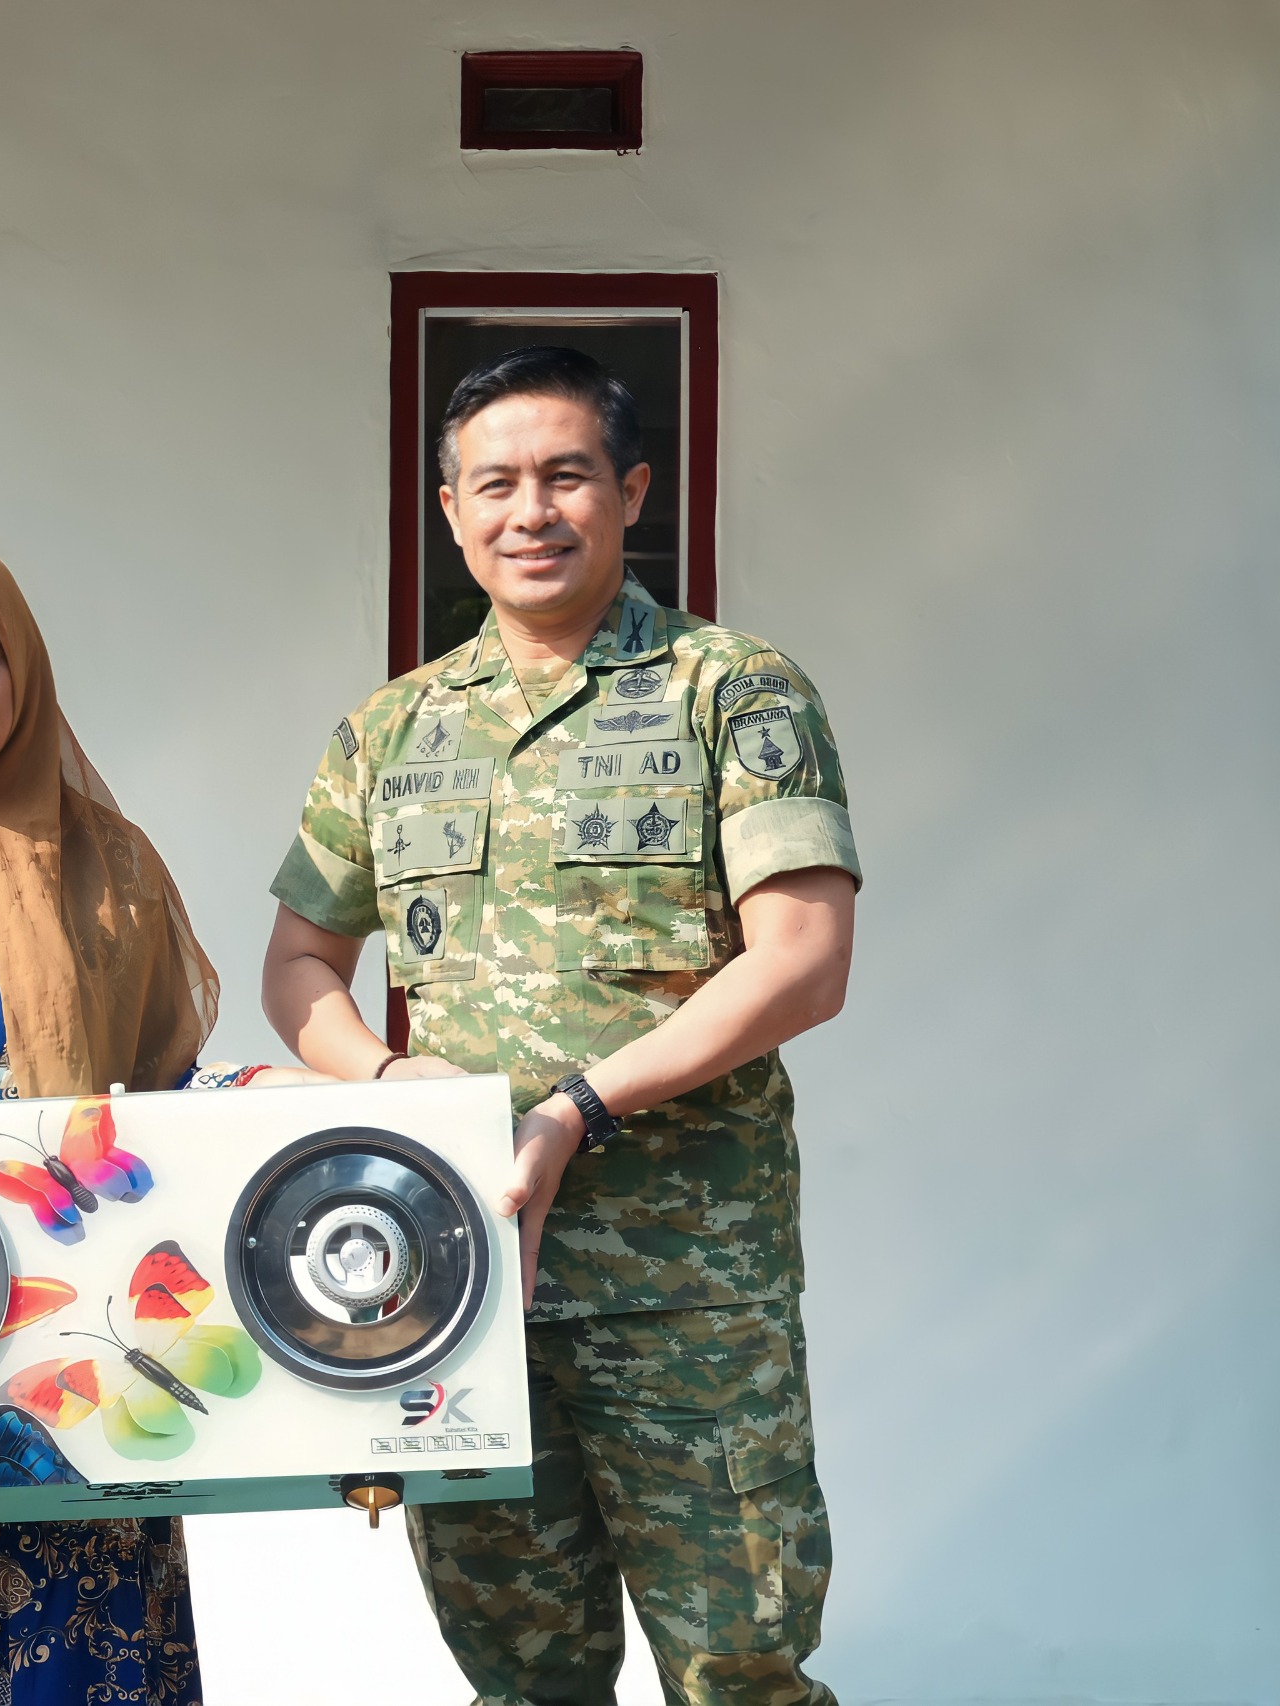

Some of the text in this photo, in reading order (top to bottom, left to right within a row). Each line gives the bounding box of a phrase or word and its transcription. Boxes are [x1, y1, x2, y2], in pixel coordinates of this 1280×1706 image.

[578, 750, 681, 778] TNI AD
[382, 771, 444, 801] DHAVID
